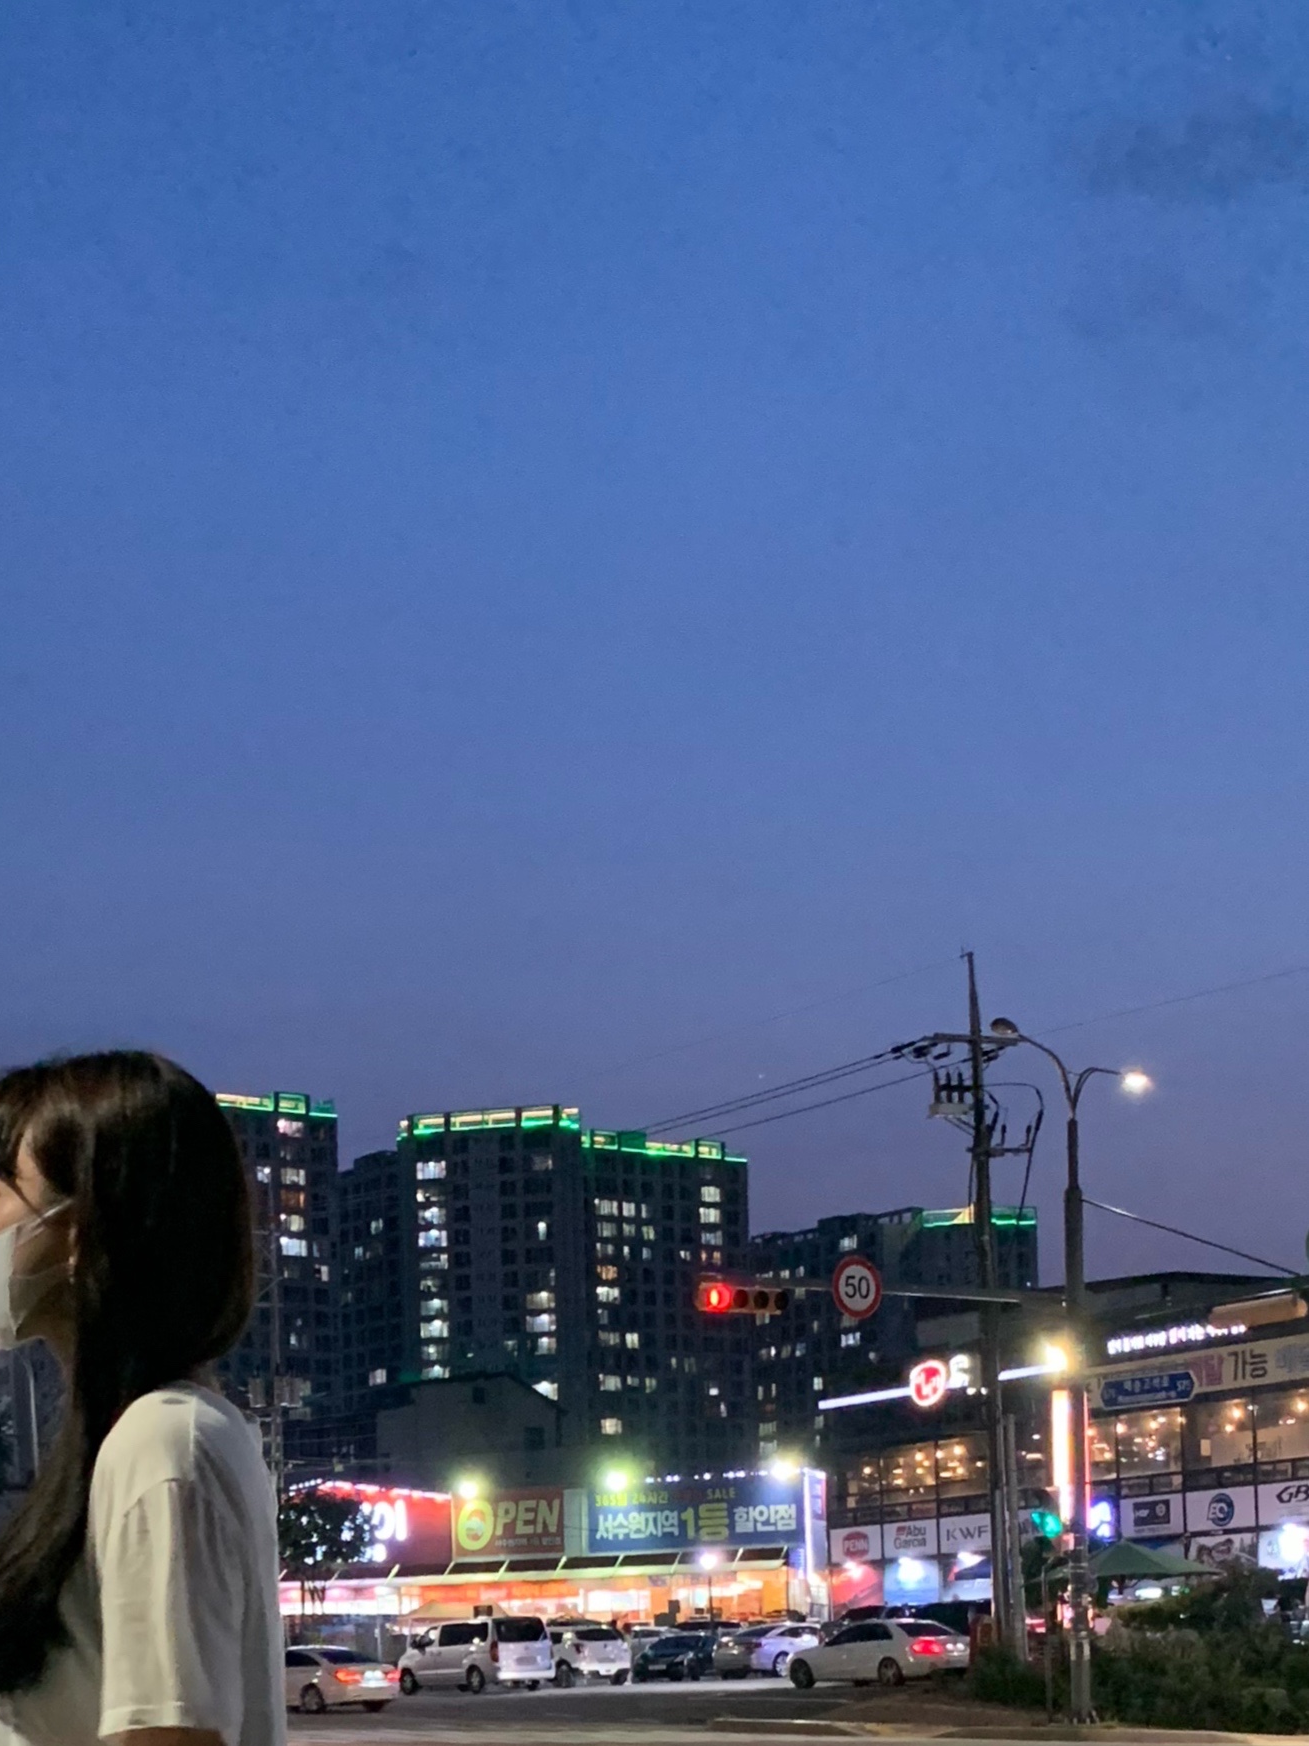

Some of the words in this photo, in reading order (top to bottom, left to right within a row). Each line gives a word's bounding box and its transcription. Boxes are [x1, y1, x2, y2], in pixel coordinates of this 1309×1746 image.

[844, 1275, 870, 1299] 50
[1227, 1349, 1268, 1382] 가능
[632, 1490, 669, 1505] 24시간
[706, 1487, 736, 1500] SALE
[457, 1498, 561, 1551] OPEN
[595, 1509, 680, 1541] 서수원지역
[681, 1502, 730, 1542] 1등
[733, 1504, 797, 1533] 할인점
[905, 1525, 926, 1537] Abu
[946, 1524, 989, 1541] KWF
[843, 1536, 869, 1551] PENN
[894, 1536, 927, 1549] Garcia
